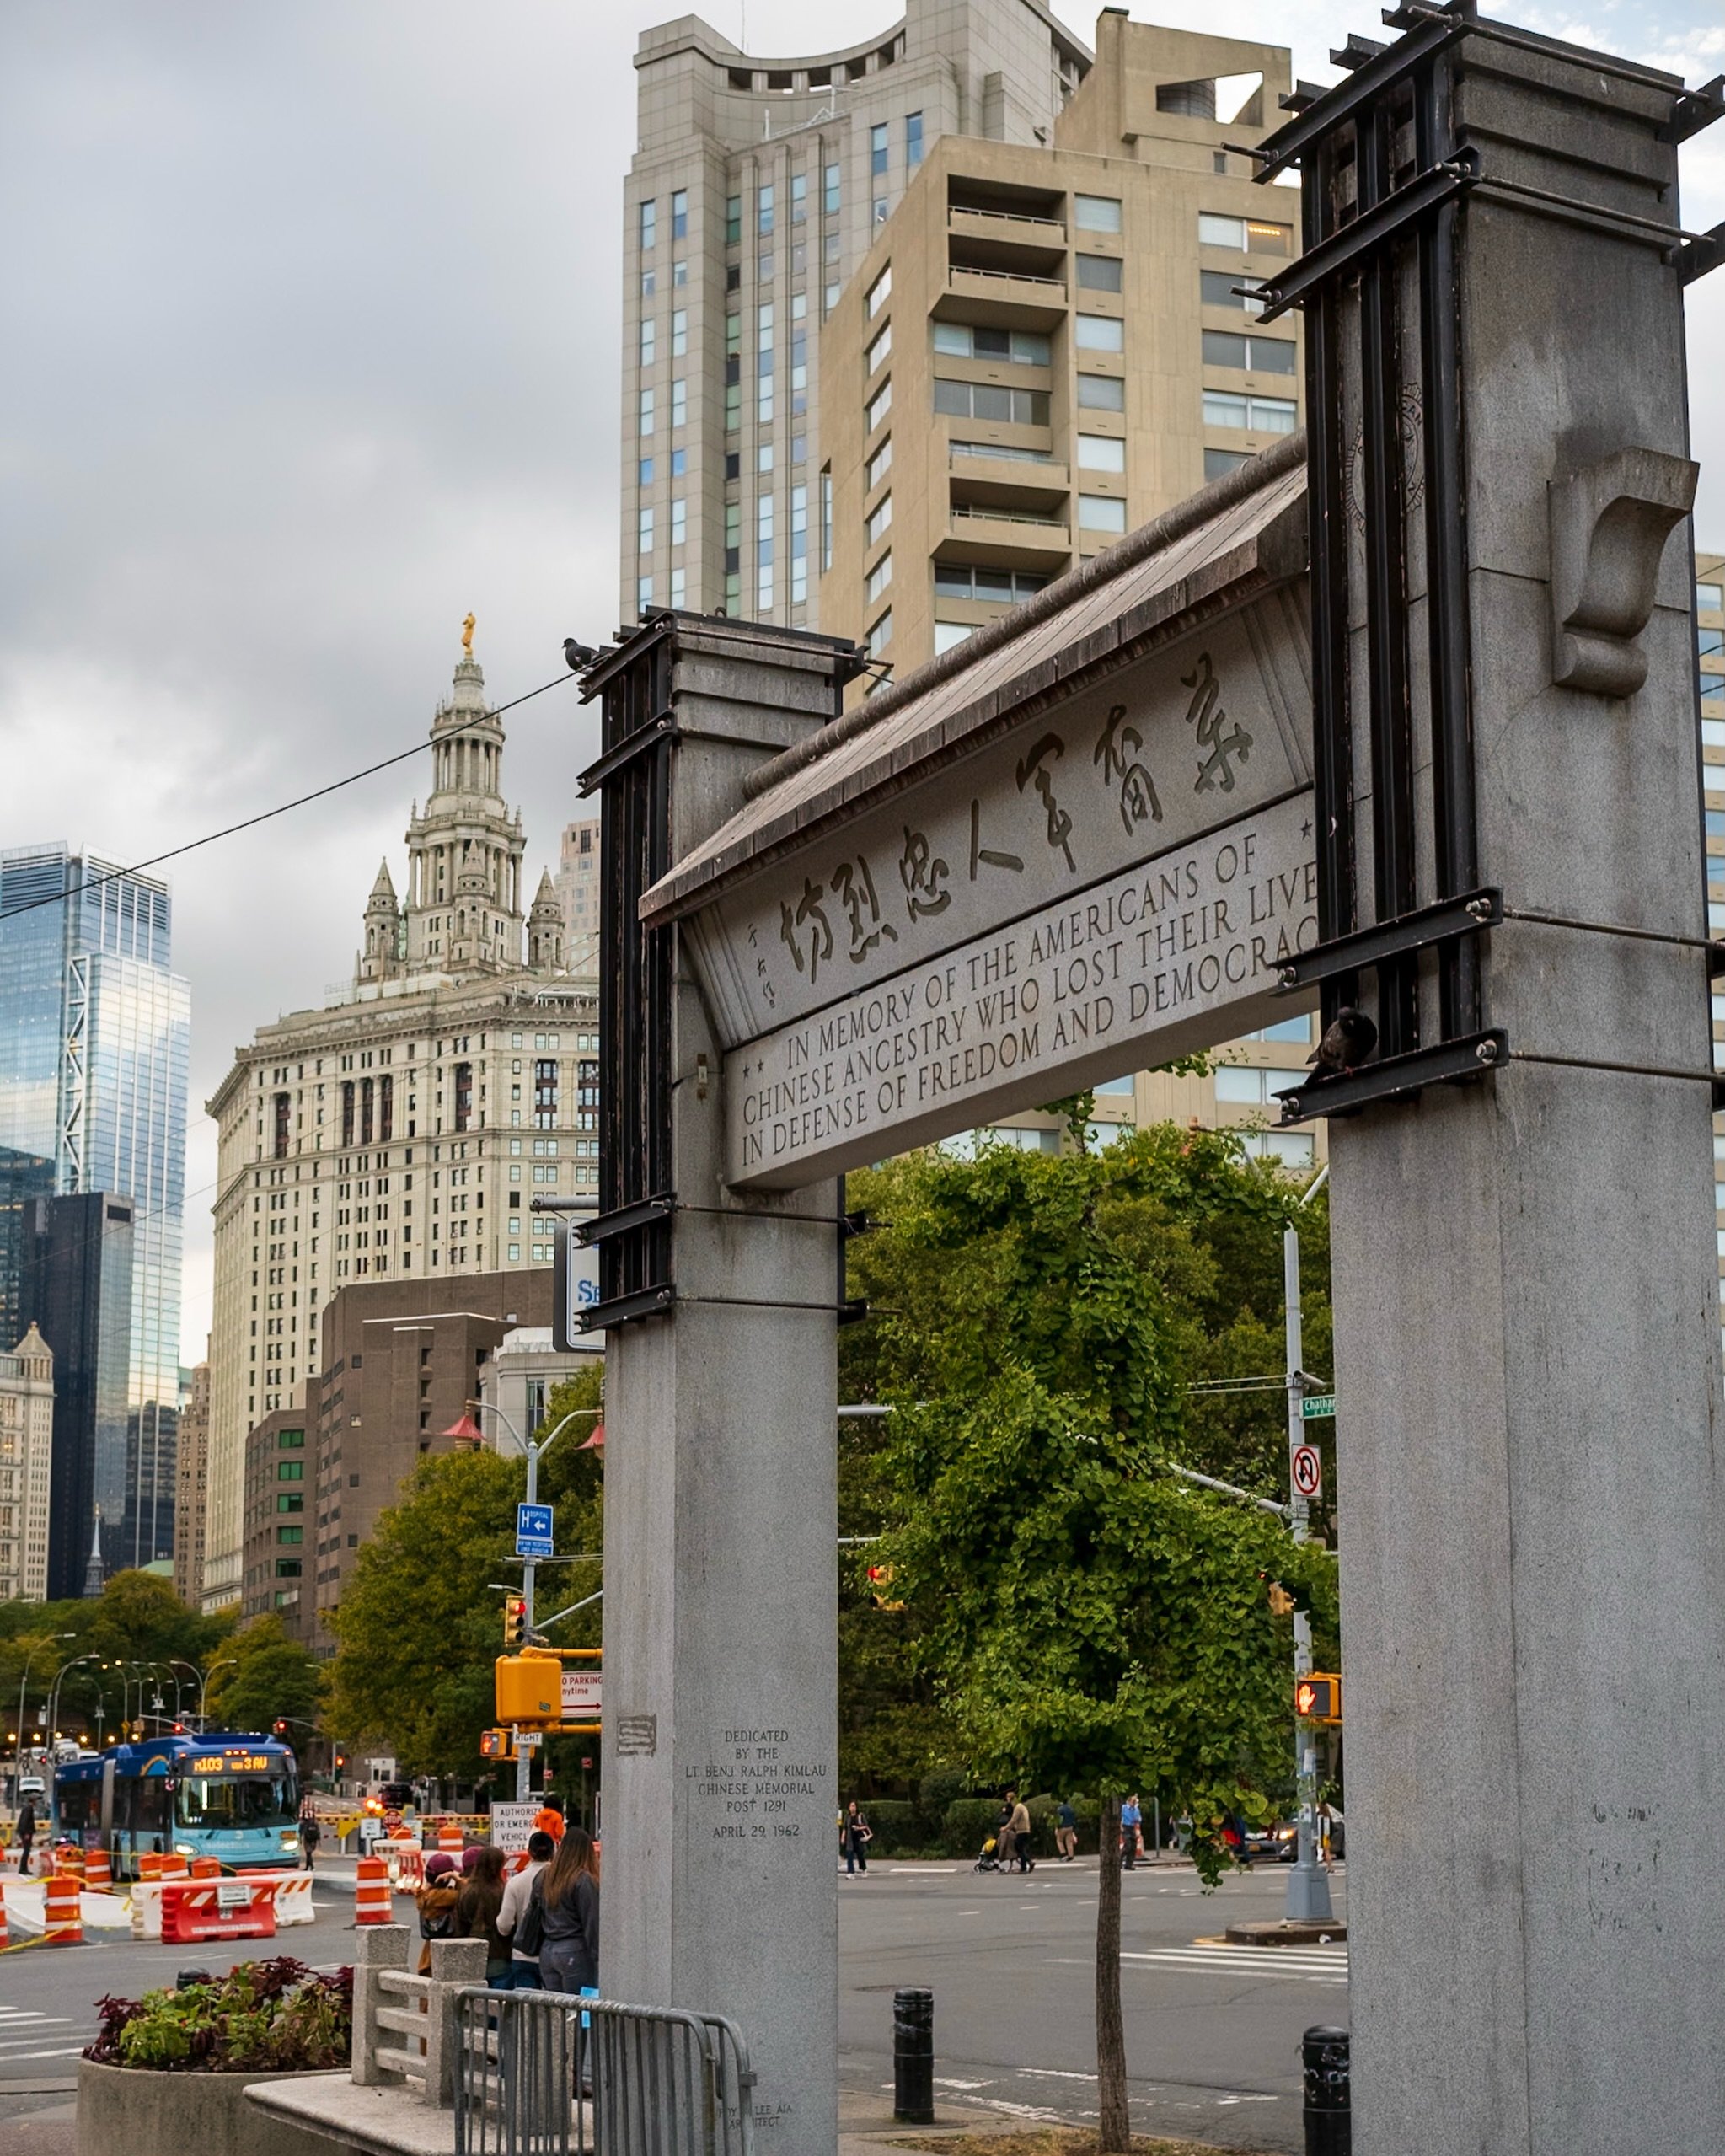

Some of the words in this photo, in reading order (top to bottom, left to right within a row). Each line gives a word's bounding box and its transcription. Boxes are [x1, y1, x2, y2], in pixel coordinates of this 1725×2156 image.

[788, 1030, 810, 1070] IN
[819, 984, 915, 1056] MEMORY
[925, 967, 956, 1008] OF
[967, 941, 1018, 991] THE
[1029, 860, 1198, 967] AMERICANS
[1216, 833, 1256, 883] OF
[743, 1062, 834, 1125] CHINESE
[843, 1006, 967, 1087] ANCESTRY
[975, 978, 1039, 1032] WHO
[1053, 941, 1123, 1003] LOST
[1137, 899, 1237, 968] THEIR
[1248, 861, 1318, 925] LIVE
[742, 1129, 763, 1166] IN
[774, 1090, 868, 1156] DEFENSE
[877, 1074, 907, 1113] OF
[918, 1022, 1040, 1101] FREEDOM
[1052, 996, 1114, 1051] AND
[1129, 915, 1319, 1022] DEMOCRAC
[561, 1677, 567, 1686] O
[569, 1676, 603, 1685] PARKING
[561, 1687, 589, 1697] nytime
[515, 1733, 540, 1742] RIGHT
[725, 1730, 789, 1742] DEDICATED
[735, 1748, 750, 1759] BY
[757, 1748, 779, 1759] THE
[244, 1757, 252, 1769] 3
[705, 1766, 734, 1778] BENJ
[741, 1766, 778, 1778] RALPH
[784, 1765, 827, 1777] KIMLAU
[698, 1783, 749, 1795] CHINESE
[755, 1783, 815, 1794] MEMORIAL
[726, 1798, 757, 1812] POST
[763, 1800, 786, 1812] 1291
[494, 1820, 505, 1828] OR
[507, 1820, 533, 1829] EMERG
[501, 1832, 528, 1841] VEHICL
[713, 1826, 746, 1838] APRIL
[774, 1825, 800, 1837] 1962
[754, 2105, 771, 2115] LEE
[776, 2104, 792, 2114] AIA
